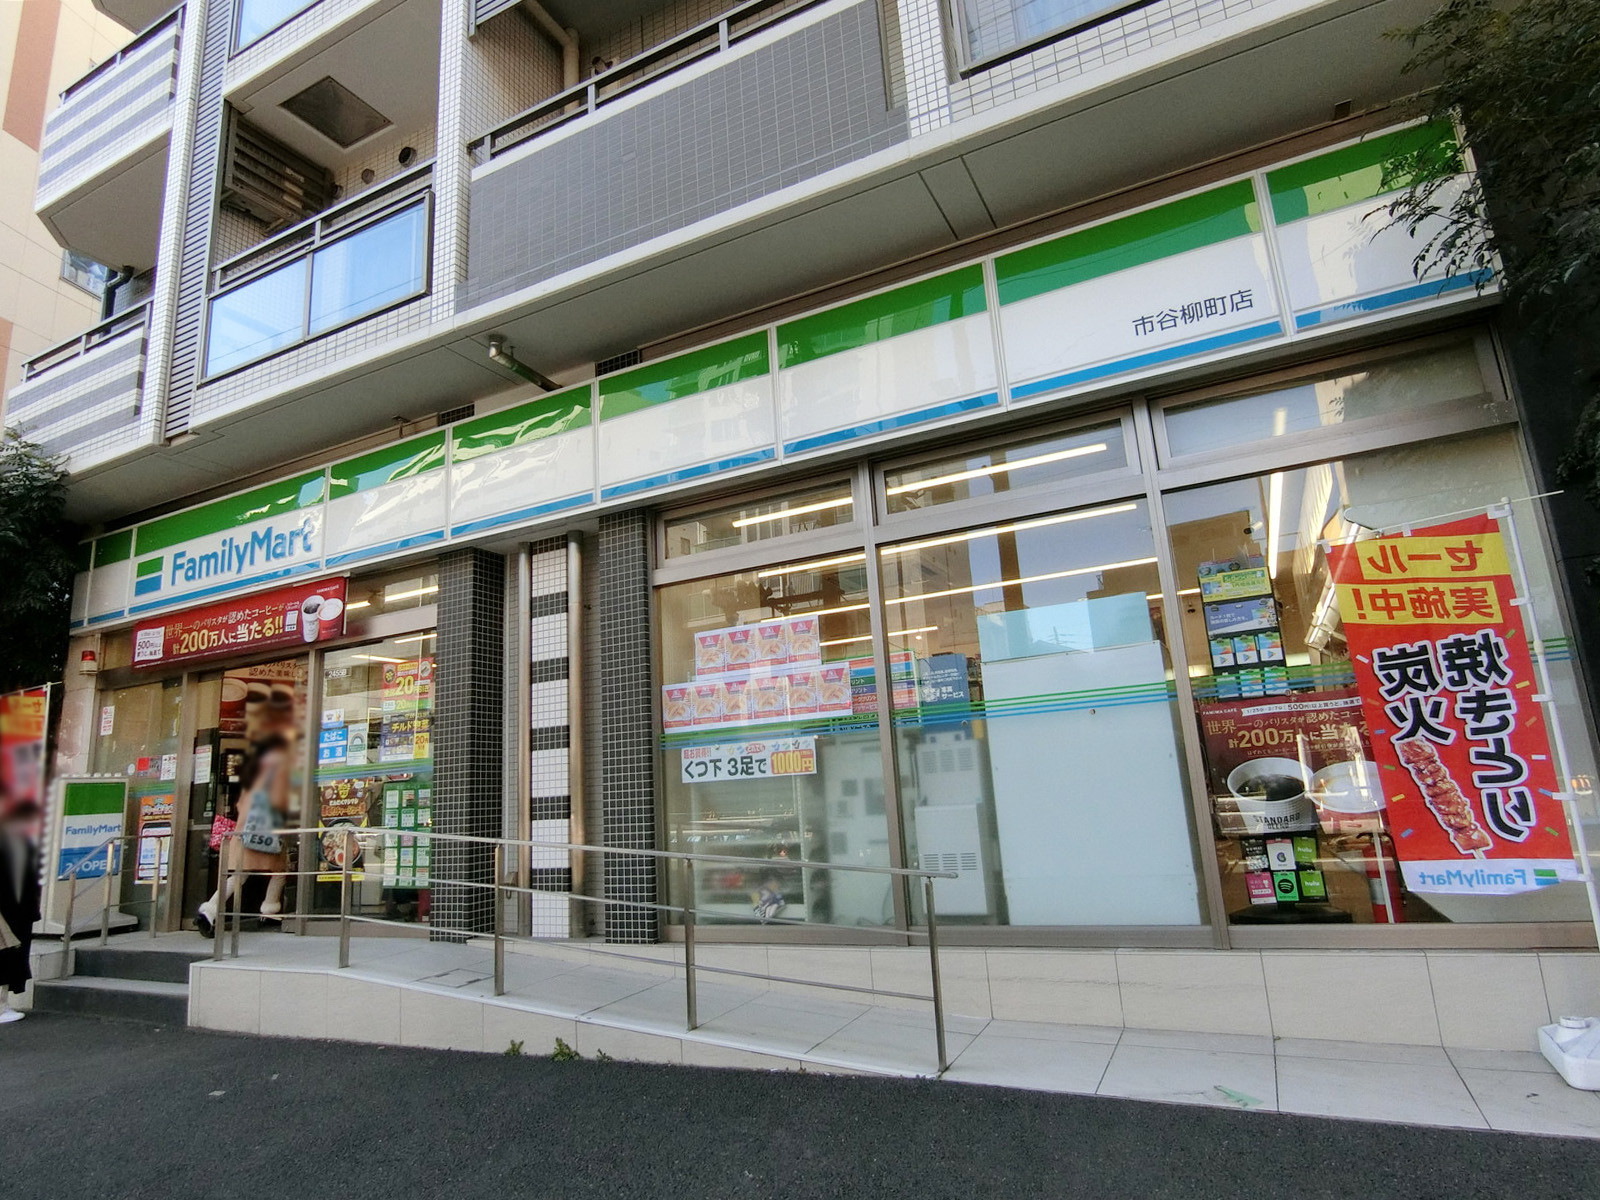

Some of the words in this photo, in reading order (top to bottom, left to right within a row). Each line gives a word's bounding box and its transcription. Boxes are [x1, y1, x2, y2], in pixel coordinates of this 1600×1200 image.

[1132, 289, 1254, 337] 市谷柳町店
[171, 519, 314, 586] FamilyMart
[684, 758, 722, 779] くつ下
[727, 755, 767, 777] 3足で
[771, 750, 814, 774] 1000円
[65, 823, 122, 836] FamilyMart
